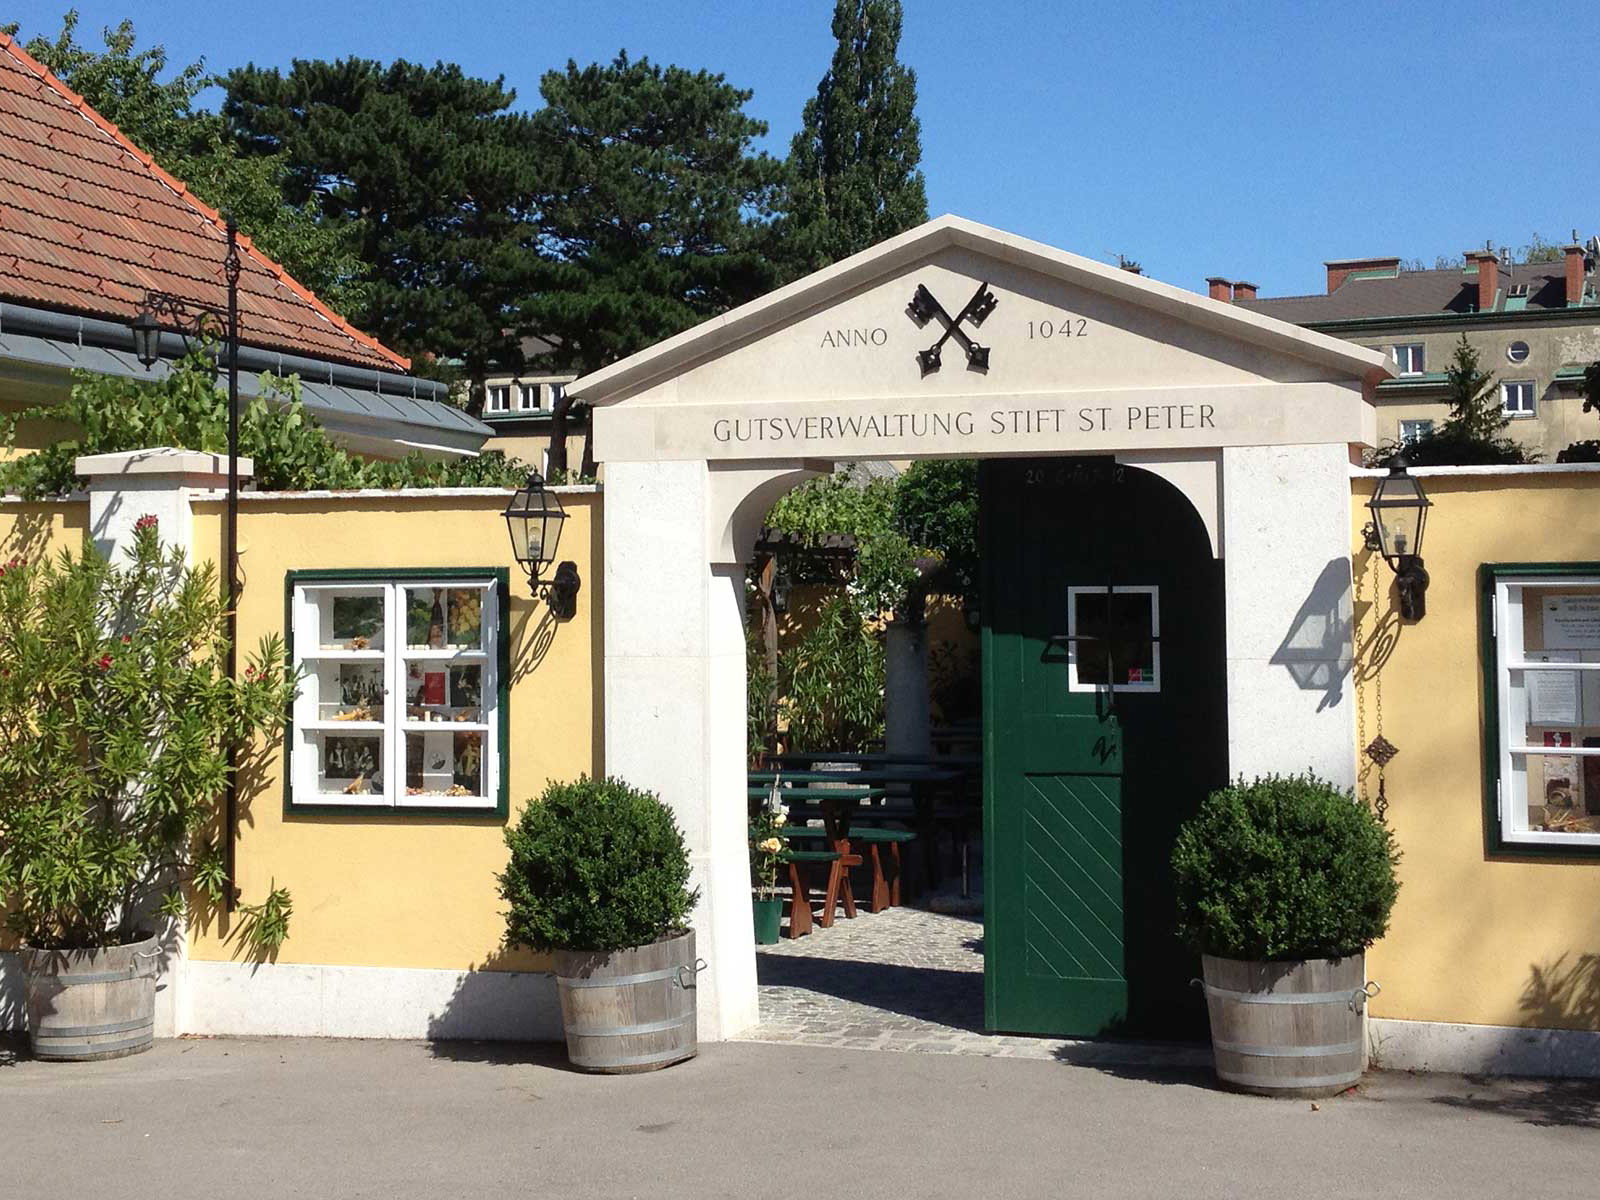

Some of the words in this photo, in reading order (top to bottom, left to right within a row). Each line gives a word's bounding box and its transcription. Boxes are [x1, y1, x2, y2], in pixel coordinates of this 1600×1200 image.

[821, 328, 888, 348] ANNO
[1027, 319, 1088, 340] 1042
[713, 411, 974, 442] GUTSVERWALTUNG
[991, 408, 1065, 434] STIFT
[1079, 407, 1112, 432] ST.
[1128, 404, 1215, 430] PETER
